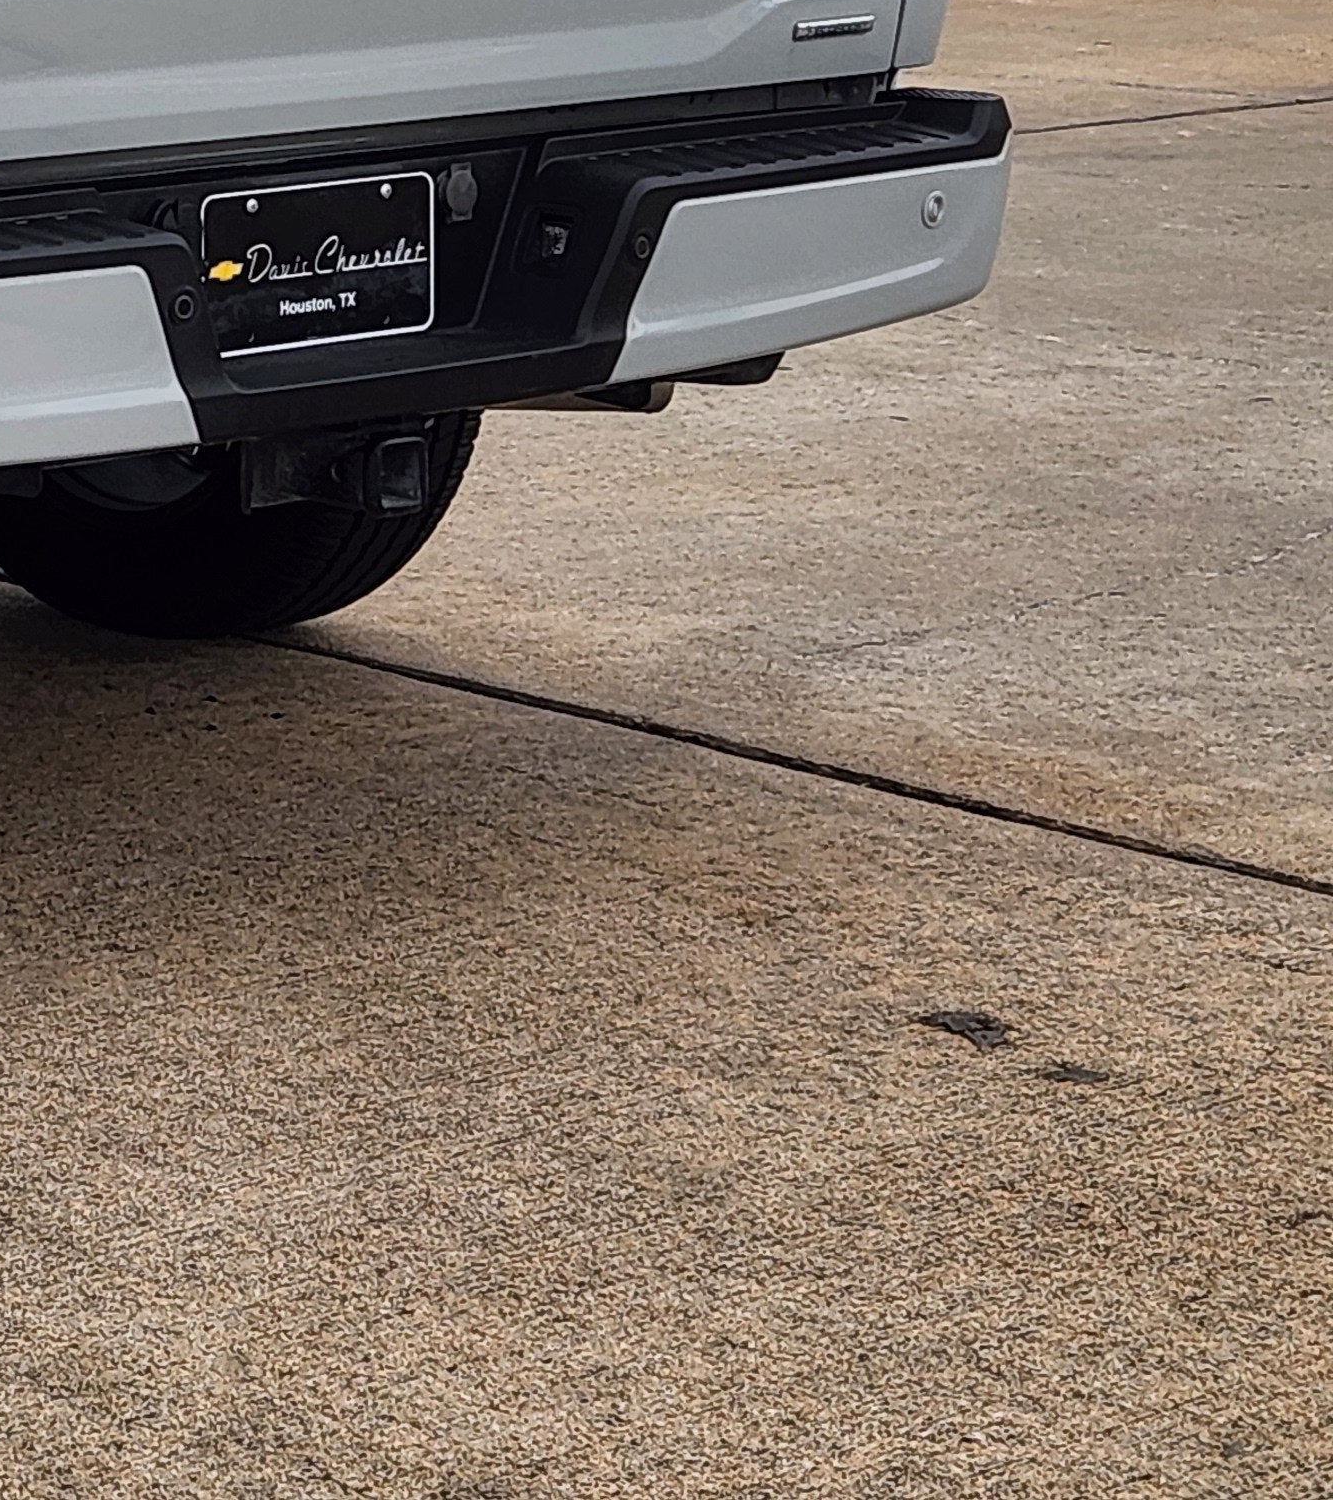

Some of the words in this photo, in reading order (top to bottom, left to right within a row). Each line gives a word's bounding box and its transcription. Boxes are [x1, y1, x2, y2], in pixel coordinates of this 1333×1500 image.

[246, 243, 314, 283] Davis
[314, 235, 428, 275] Chevrolet
[279, 296, 337, 317] Houston,
[337, 291, 357, 308] TX
